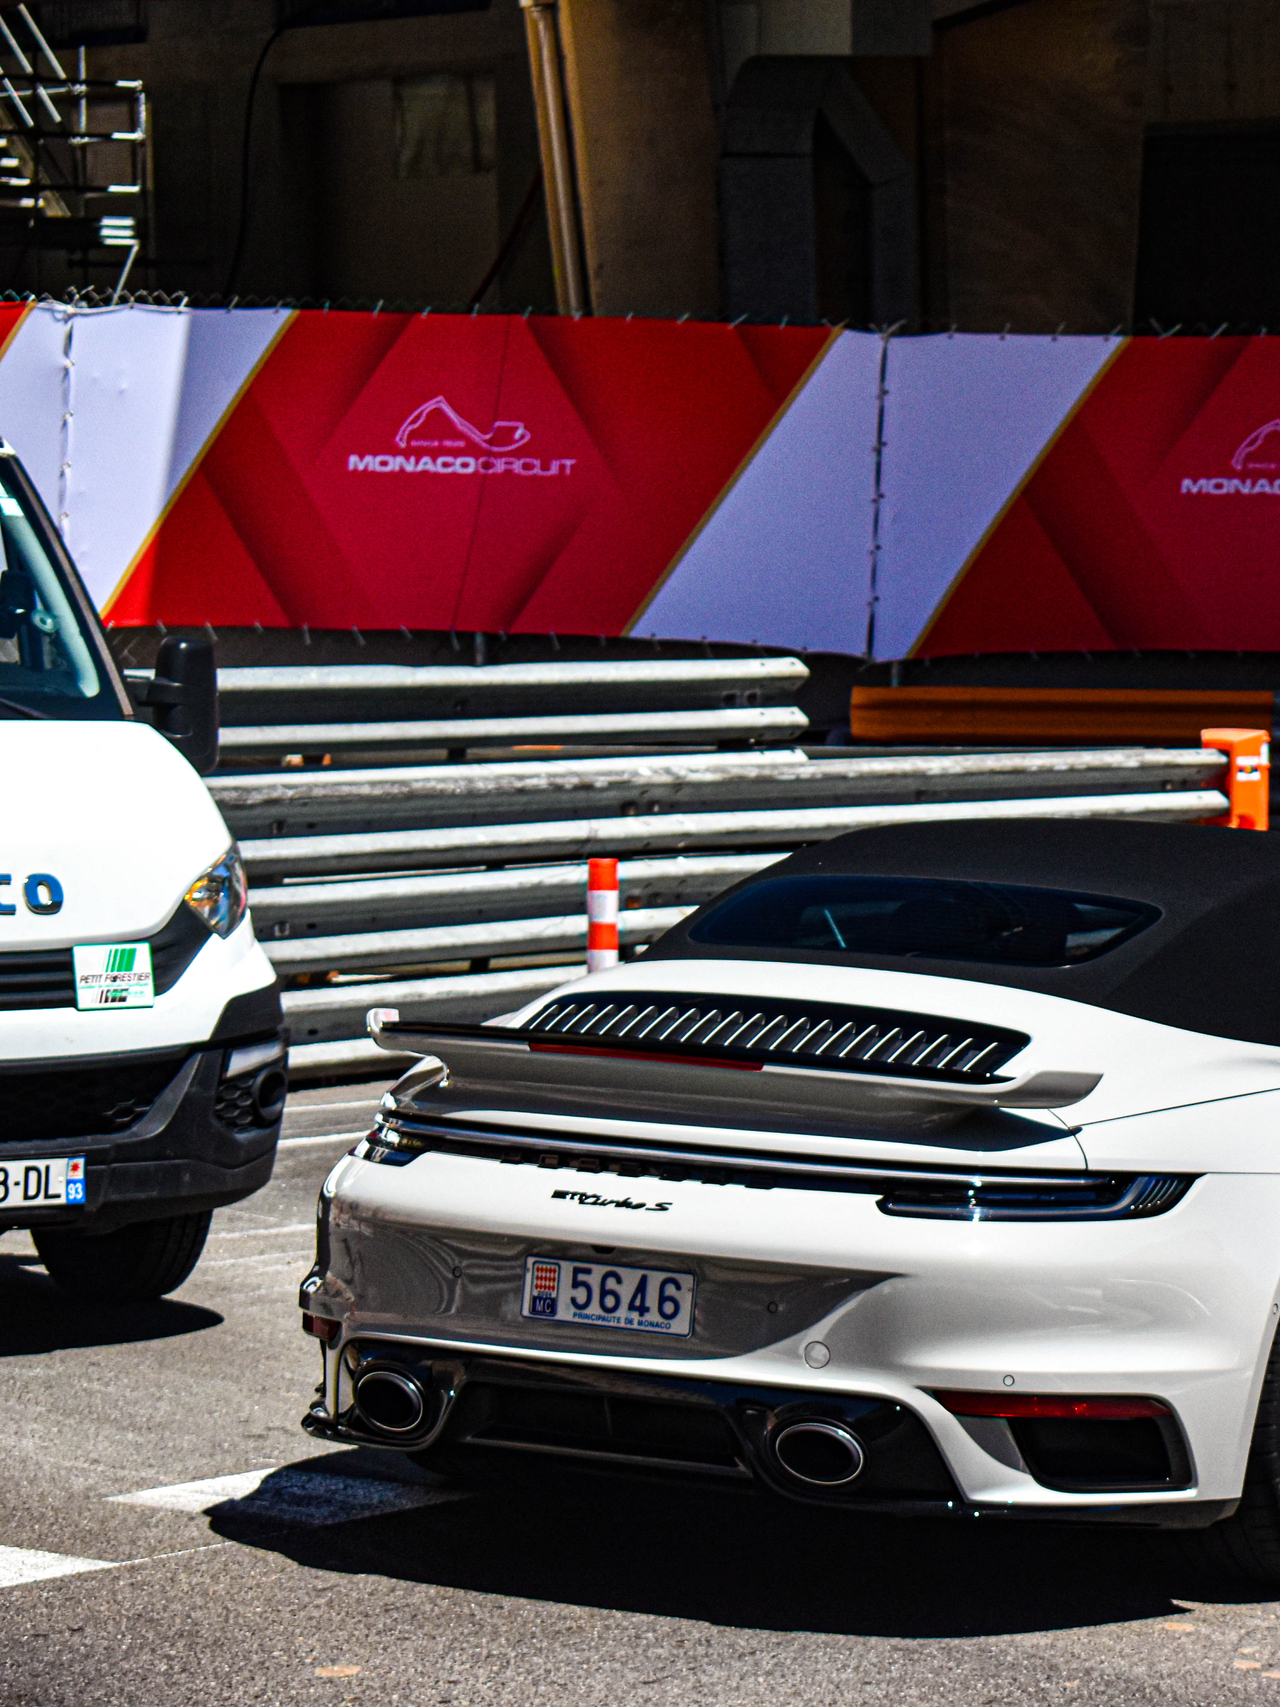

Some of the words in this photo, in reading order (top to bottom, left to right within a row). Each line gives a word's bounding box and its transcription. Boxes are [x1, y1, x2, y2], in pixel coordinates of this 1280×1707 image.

[79, 974, 103, 984] PETIT
[67, 1182, 84, 1200] 93
[645, 1201, 674, 1212] S
[570, 1266, 683, 1321] 5646
[535, 1298, 552, 1313] MC
[624, 1317, 635, 1326] DE
[637, 1319, 672, 1330] MONACO
